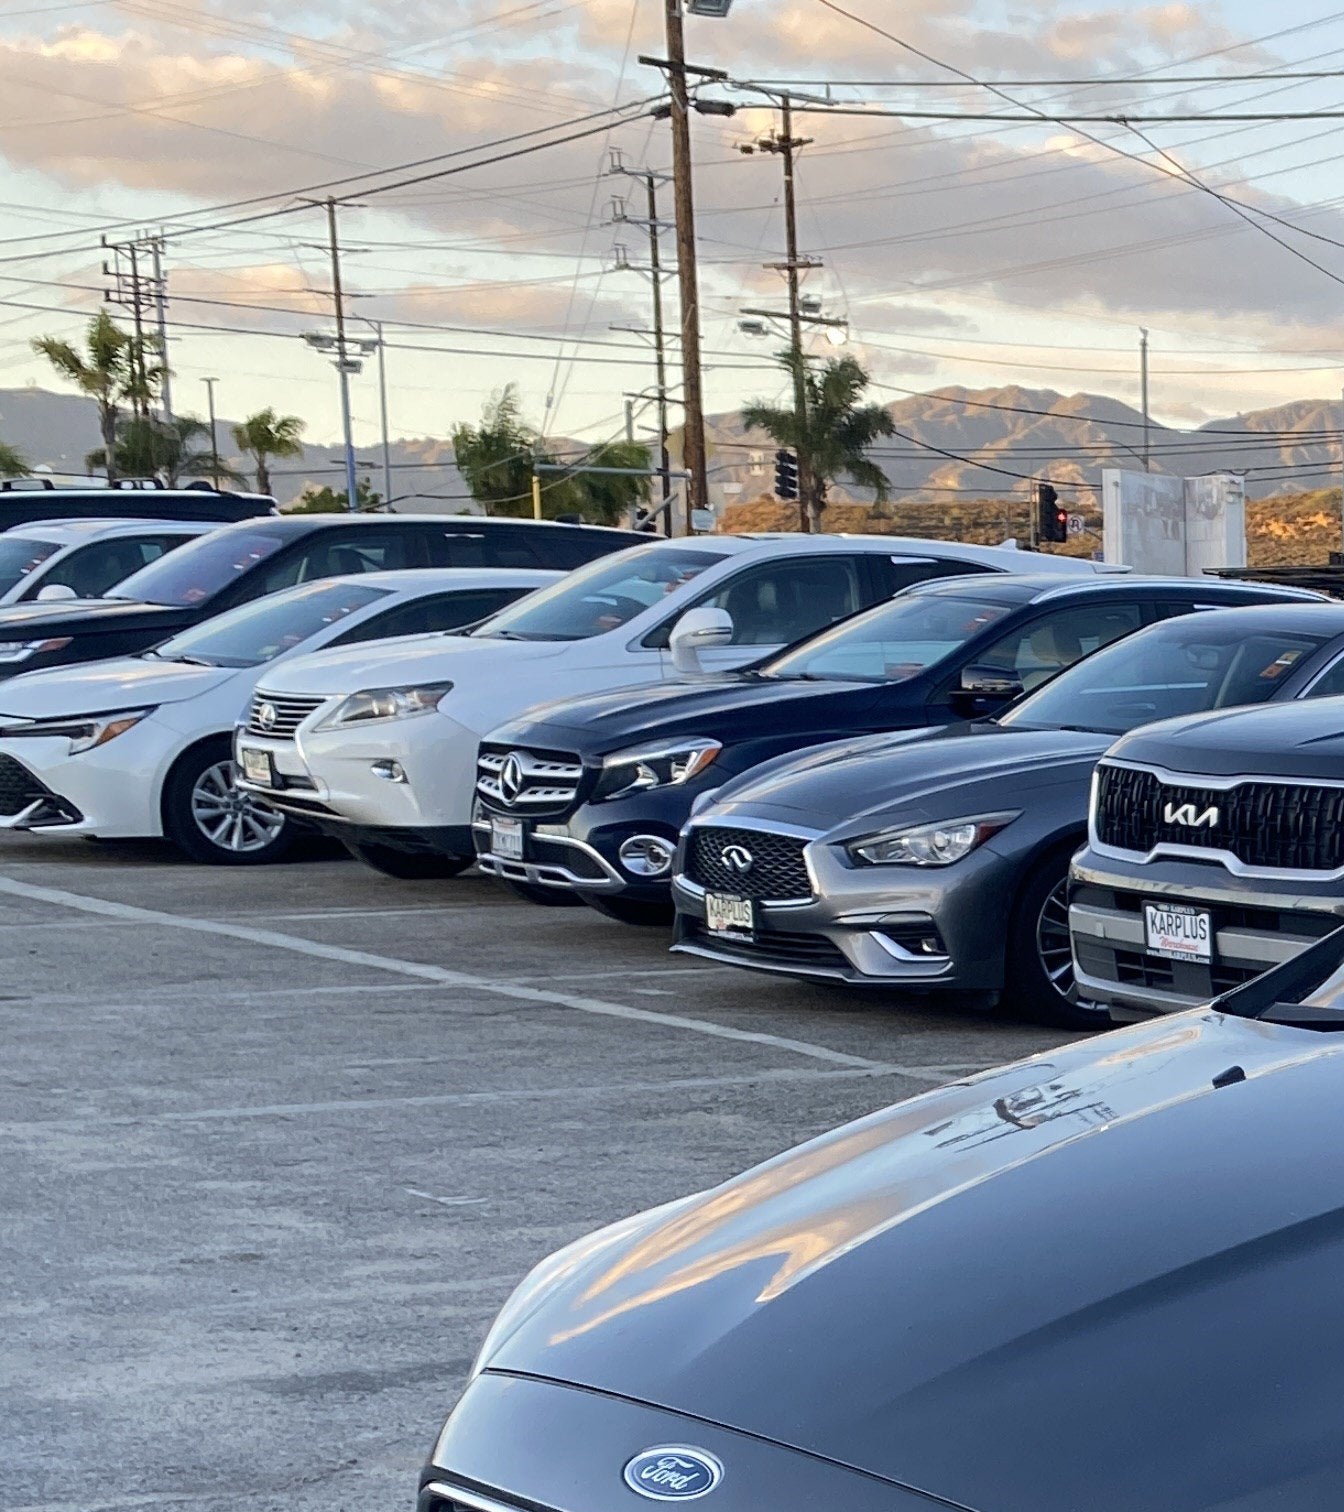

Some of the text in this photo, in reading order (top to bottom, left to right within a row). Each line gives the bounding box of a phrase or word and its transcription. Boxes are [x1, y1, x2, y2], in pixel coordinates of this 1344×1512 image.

[1164, 802, 1218, 828] KIA
[1149, 911, 1207, 940] KARPLUS
[641, 1456, 700, 1490] Ford
